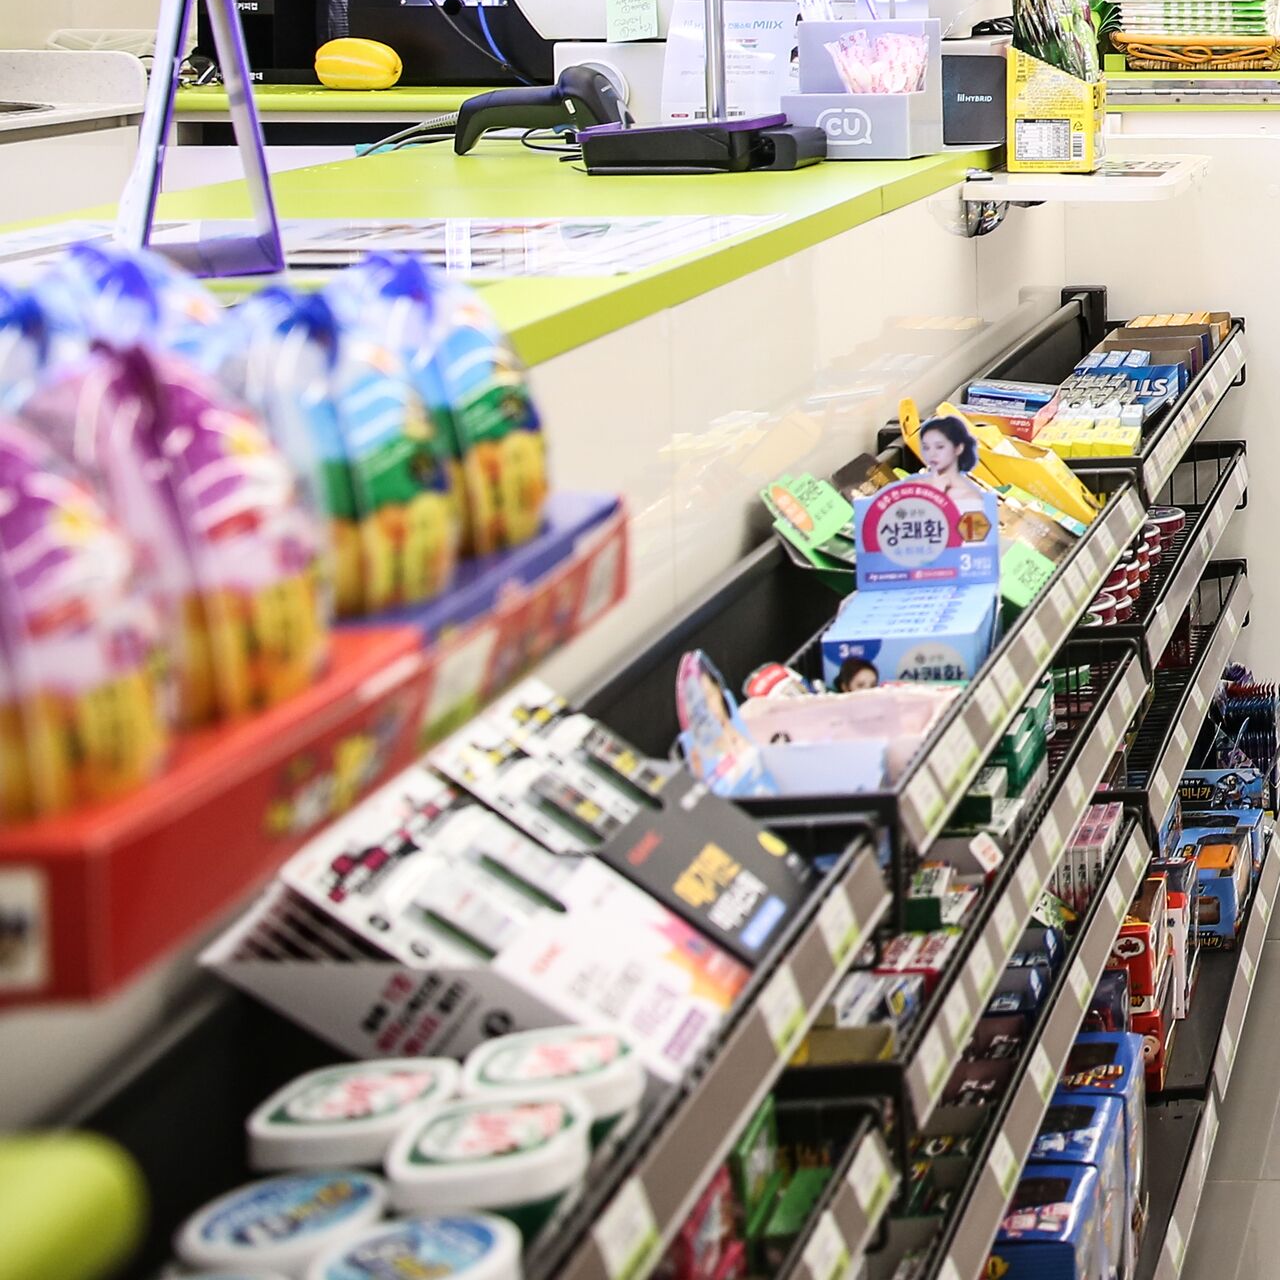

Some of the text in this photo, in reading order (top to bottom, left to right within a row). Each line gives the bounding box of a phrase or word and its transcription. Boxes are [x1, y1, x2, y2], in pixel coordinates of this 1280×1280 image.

[753, 20, 783, 30] MIIX
[965, 94, 993, 103] HYBRID
[826, 116, 860, 136] CU
[880, 520, 946, 546] 상쾌환
